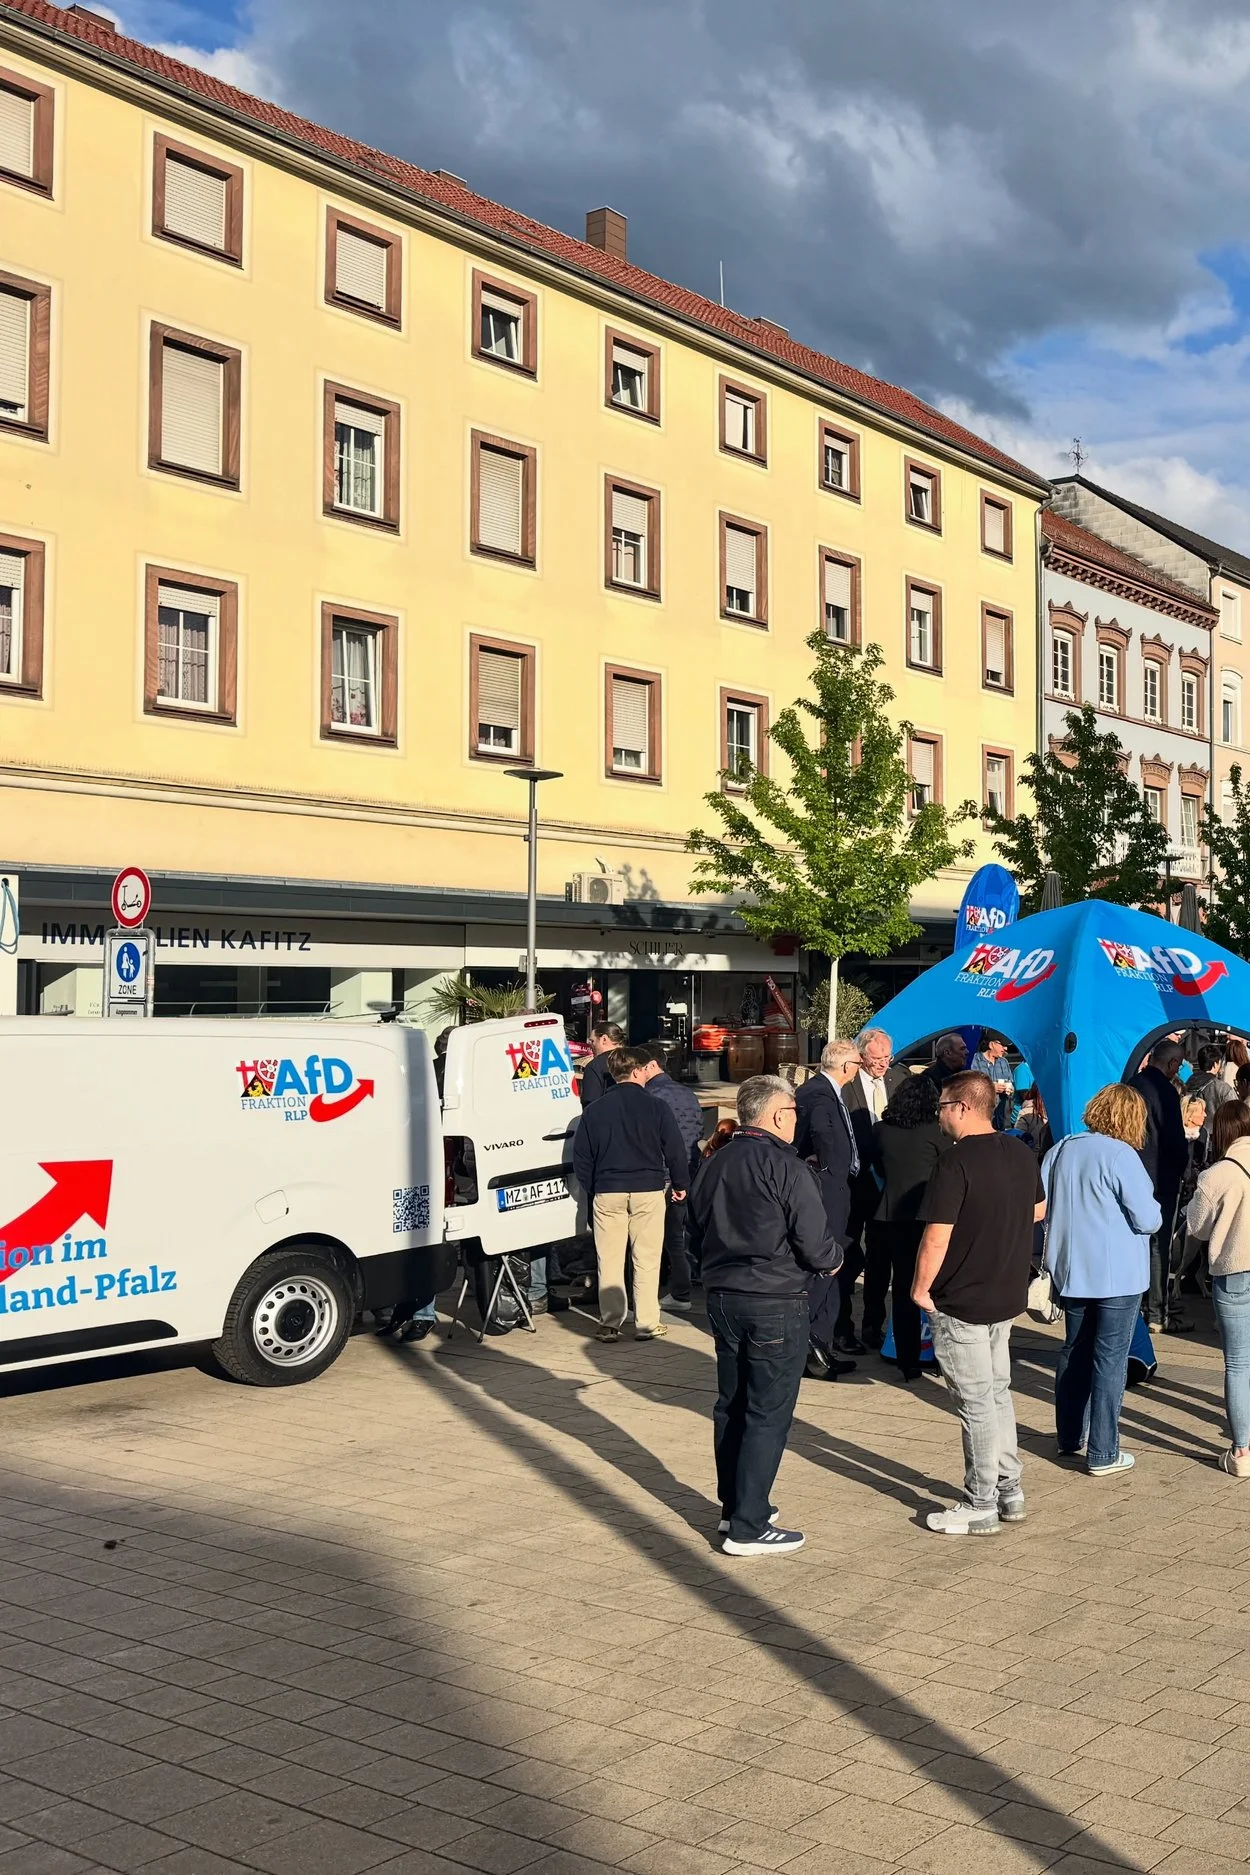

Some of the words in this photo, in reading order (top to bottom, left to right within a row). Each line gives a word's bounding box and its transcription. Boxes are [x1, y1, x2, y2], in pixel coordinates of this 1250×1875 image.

[976, 907, 1006, 929] AfD
[42, 923, 209, 949] IMMLIEN
[221, 929, 312, 951] KAFITZ
[984, 948, 1054, 980] AfD
[1130, 946, 1203, 975] AfD
[955, 973, 1005, 987] FRAKTION
[1114, 967, 1168, 983] FRAKTION
[118, 984, 137, 995] ZONE
[977, 988, 998, 998] RLP
[1152, 982, 1174, 993] RLP
[273, 1054, 353, 1096] AfD
[512, 1073, 569, 1092] FRAKTION
[551, 1087, 571, 1099] RLP
[241, 1096, 306, 1110] FRAKTION
[285, 1110, 308, 1121] RLP
[483, 1139, 524, 1152] VIVARO
[506, 1189, 522, 1205] MZ
[530, 1183, 544, 1199] AF
[61, 1233, 108, 1262] im
[0, 1265, 177, 1314] land-Pfalz
